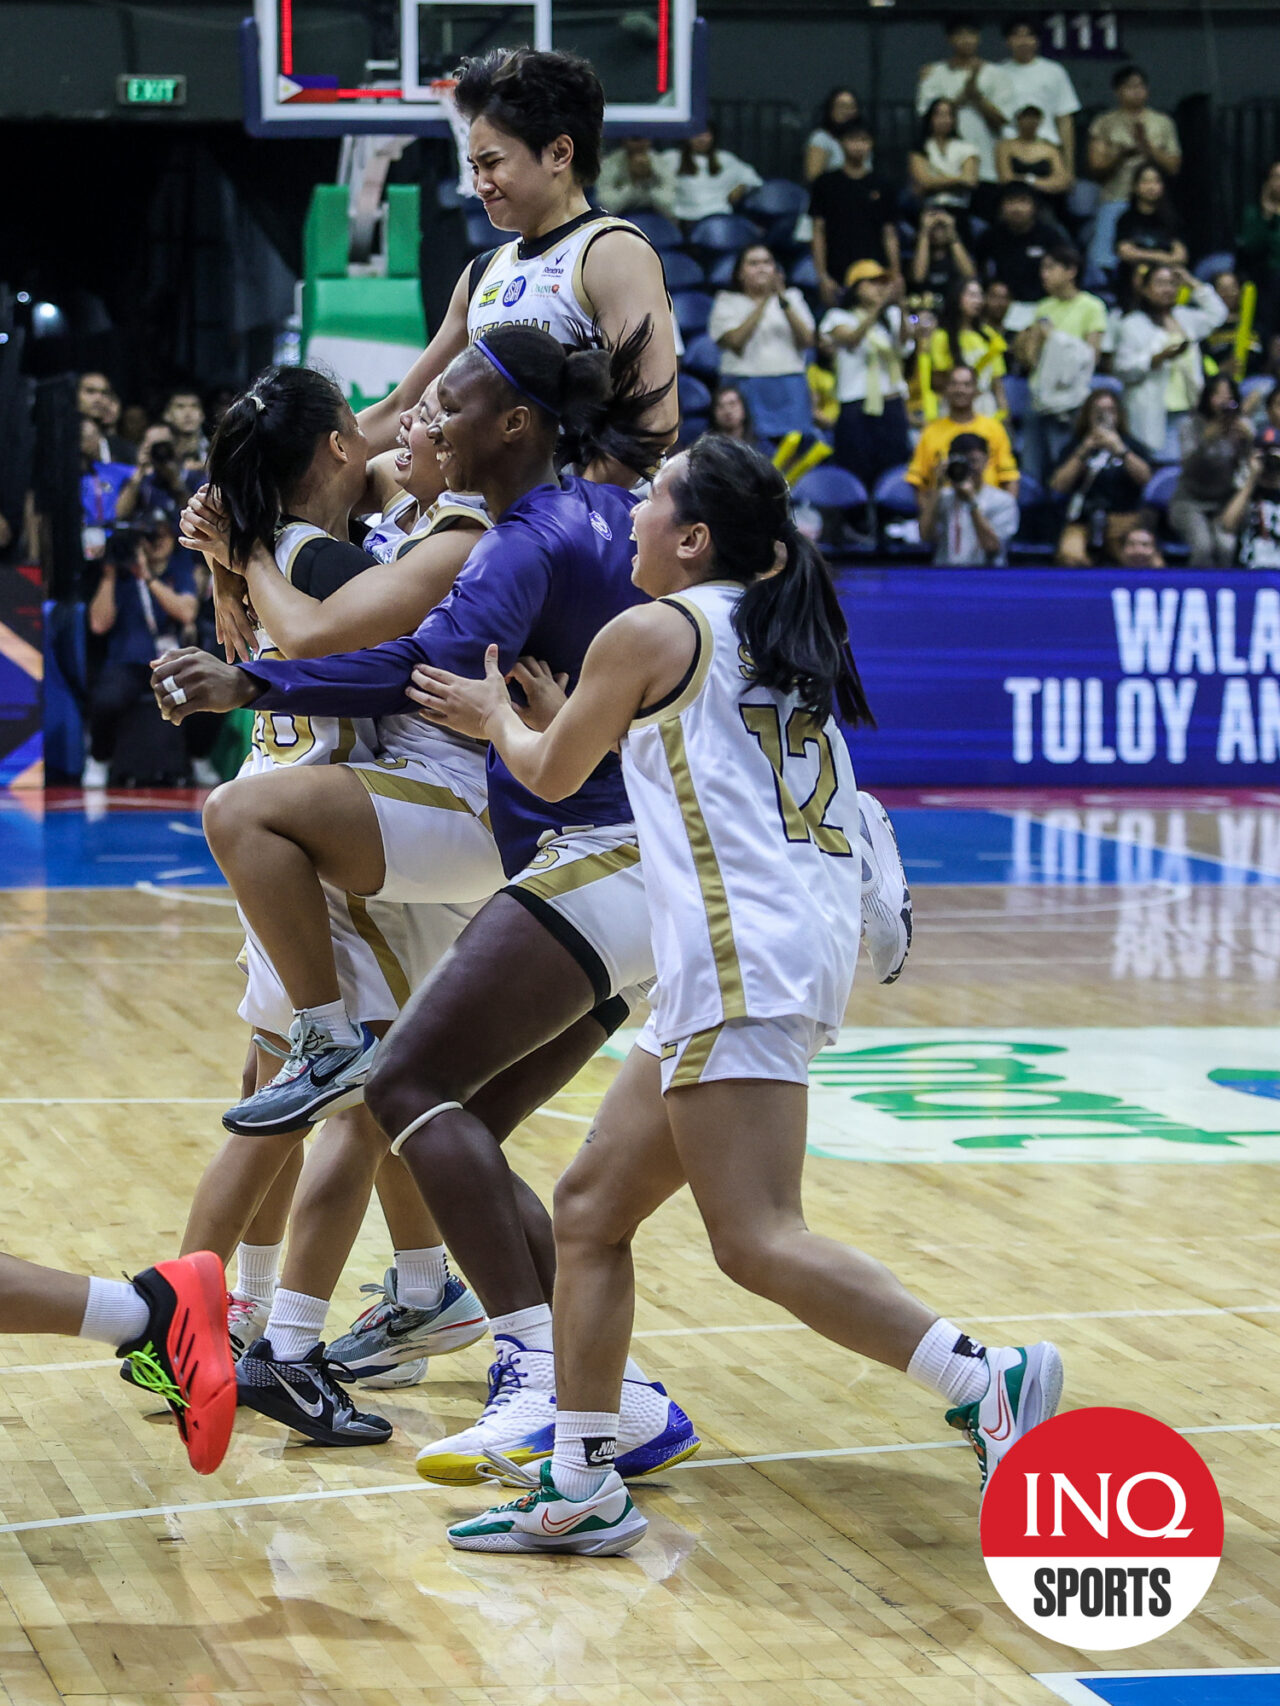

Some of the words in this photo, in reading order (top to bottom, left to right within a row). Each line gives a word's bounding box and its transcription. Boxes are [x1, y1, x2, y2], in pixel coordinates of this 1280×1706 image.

[1045, 13, 1117, 51] 111
[128, 79, 176, 102] EXIT
[1111, 587, 1280, 675] WALA
[1003, 677, 1198, 764] TULOY
[738, 703, 853, 858] 12
